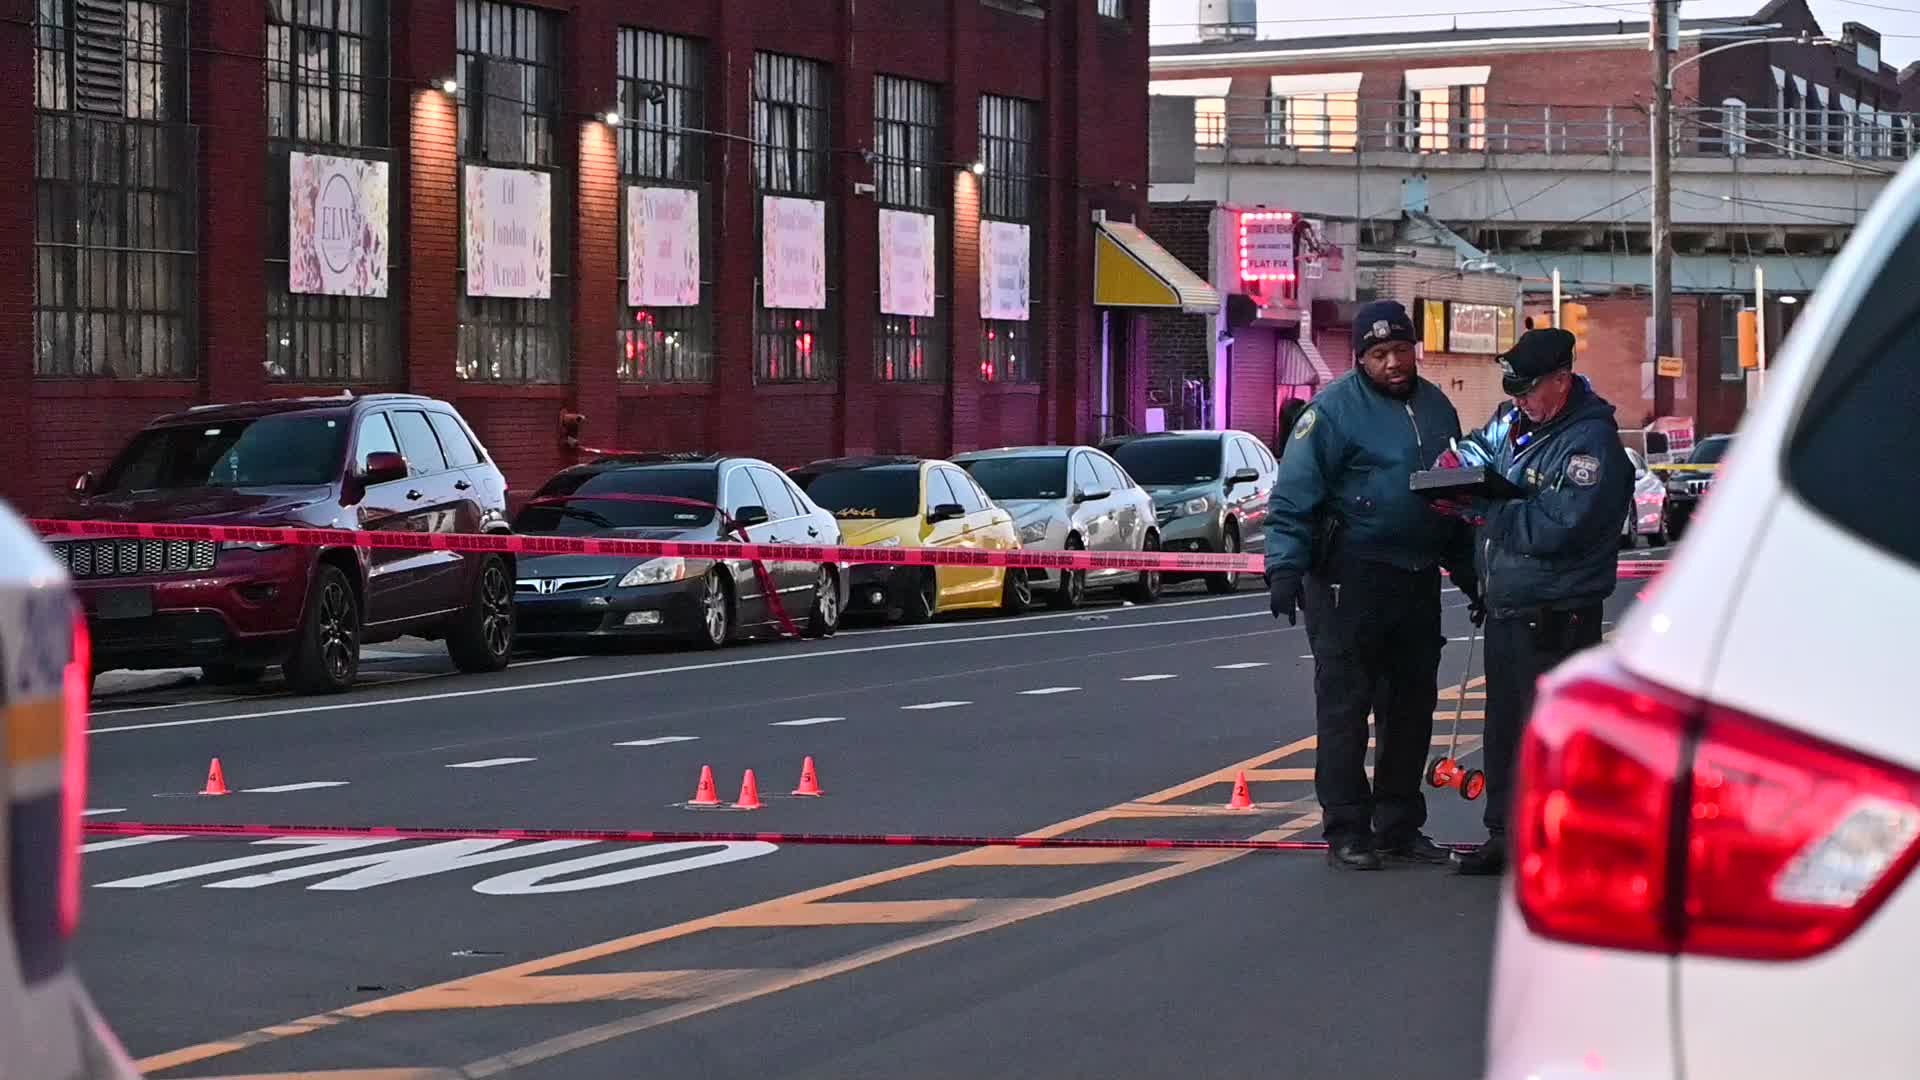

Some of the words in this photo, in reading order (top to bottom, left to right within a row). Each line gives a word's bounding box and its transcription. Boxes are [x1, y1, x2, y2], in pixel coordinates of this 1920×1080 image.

[1248, 259, 1270, 268] FLAT
[1272, 259, 1289, 268] FIX
[84, 835, 779, 895] ONL
